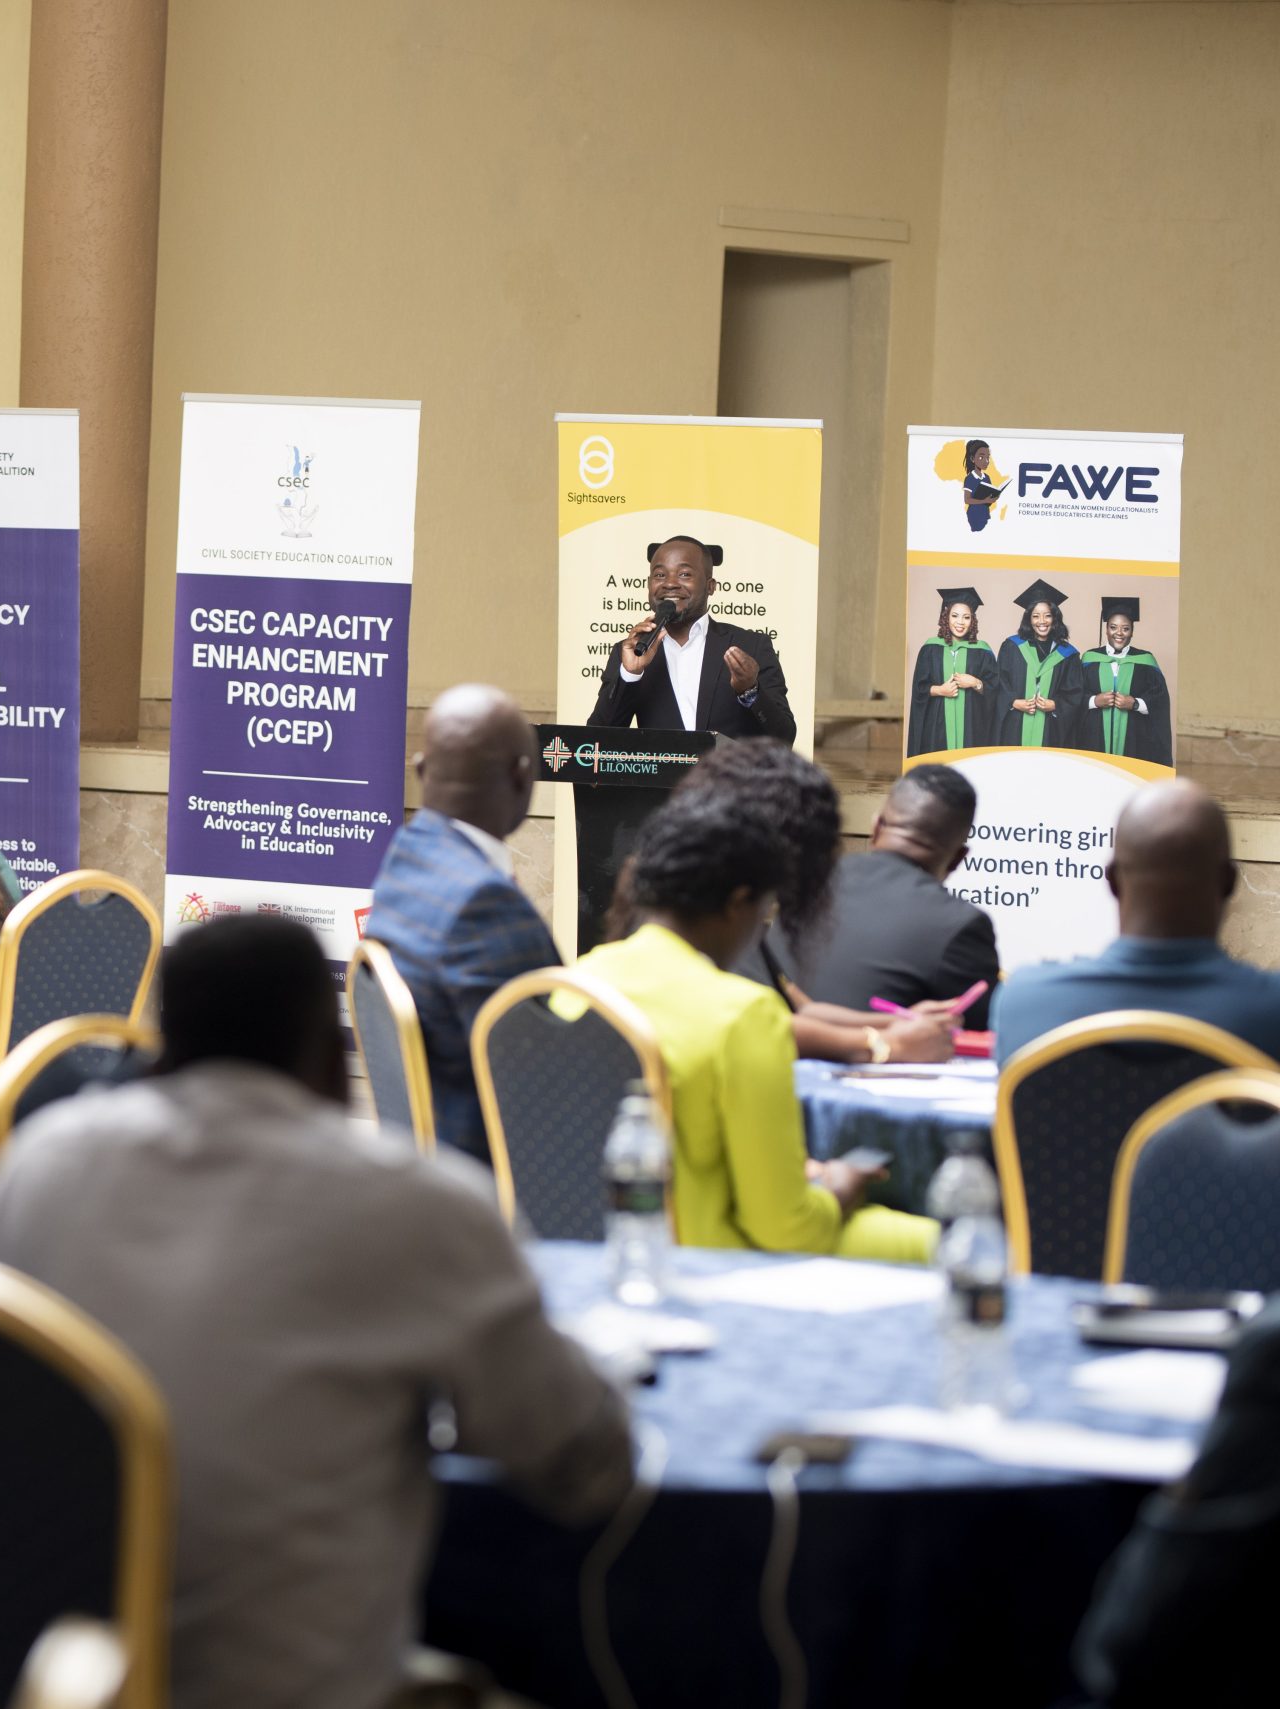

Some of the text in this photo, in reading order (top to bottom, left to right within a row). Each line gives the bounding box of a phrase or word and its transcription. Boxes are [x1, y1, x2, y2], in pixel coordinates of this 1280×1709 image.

[1018, 462, 1160, 503] FAWE
[567, 492, 626, 504] Sightsavers
[1053, 511, 1093, 519] EDUCATRICES
[1105, 506, 1159, 514] EDUCATIONALISTS
[201, 548, 393, 566] CIVIL SOCIETY EDUCATION COALITION
[606, 574, 617, 588] A
[622, 576, 649, 588] wor
[736, 582, 764, 593] one
[603, 598, 613, 610] is
[190, 607, 393, 642] CSEC CAPACITY
[590, 622, 634, 634] cause
[192, 643, 389, 677] ENHANCEMENT
[227, 681, 356, 712] PROGRAM
[247, 715, 333, 752] (CCEP)
[653, 752, 699, 764] HOTELS
[600, 762, 658, 774] LILONGWE
[188, 796, 391, 826] Strengthening Governance,
[203, 814, 375, 843] Advocacy & Inclusivity
[21, 838, 36, 852] to
[241, 835, 334, 855] in Education
[1077, 826, 1114, 850] girl
[8, 857, 60, 874] uitable,
[964, 856, 1104, 880] women thro
[282, 904, 336, 915] UK International
